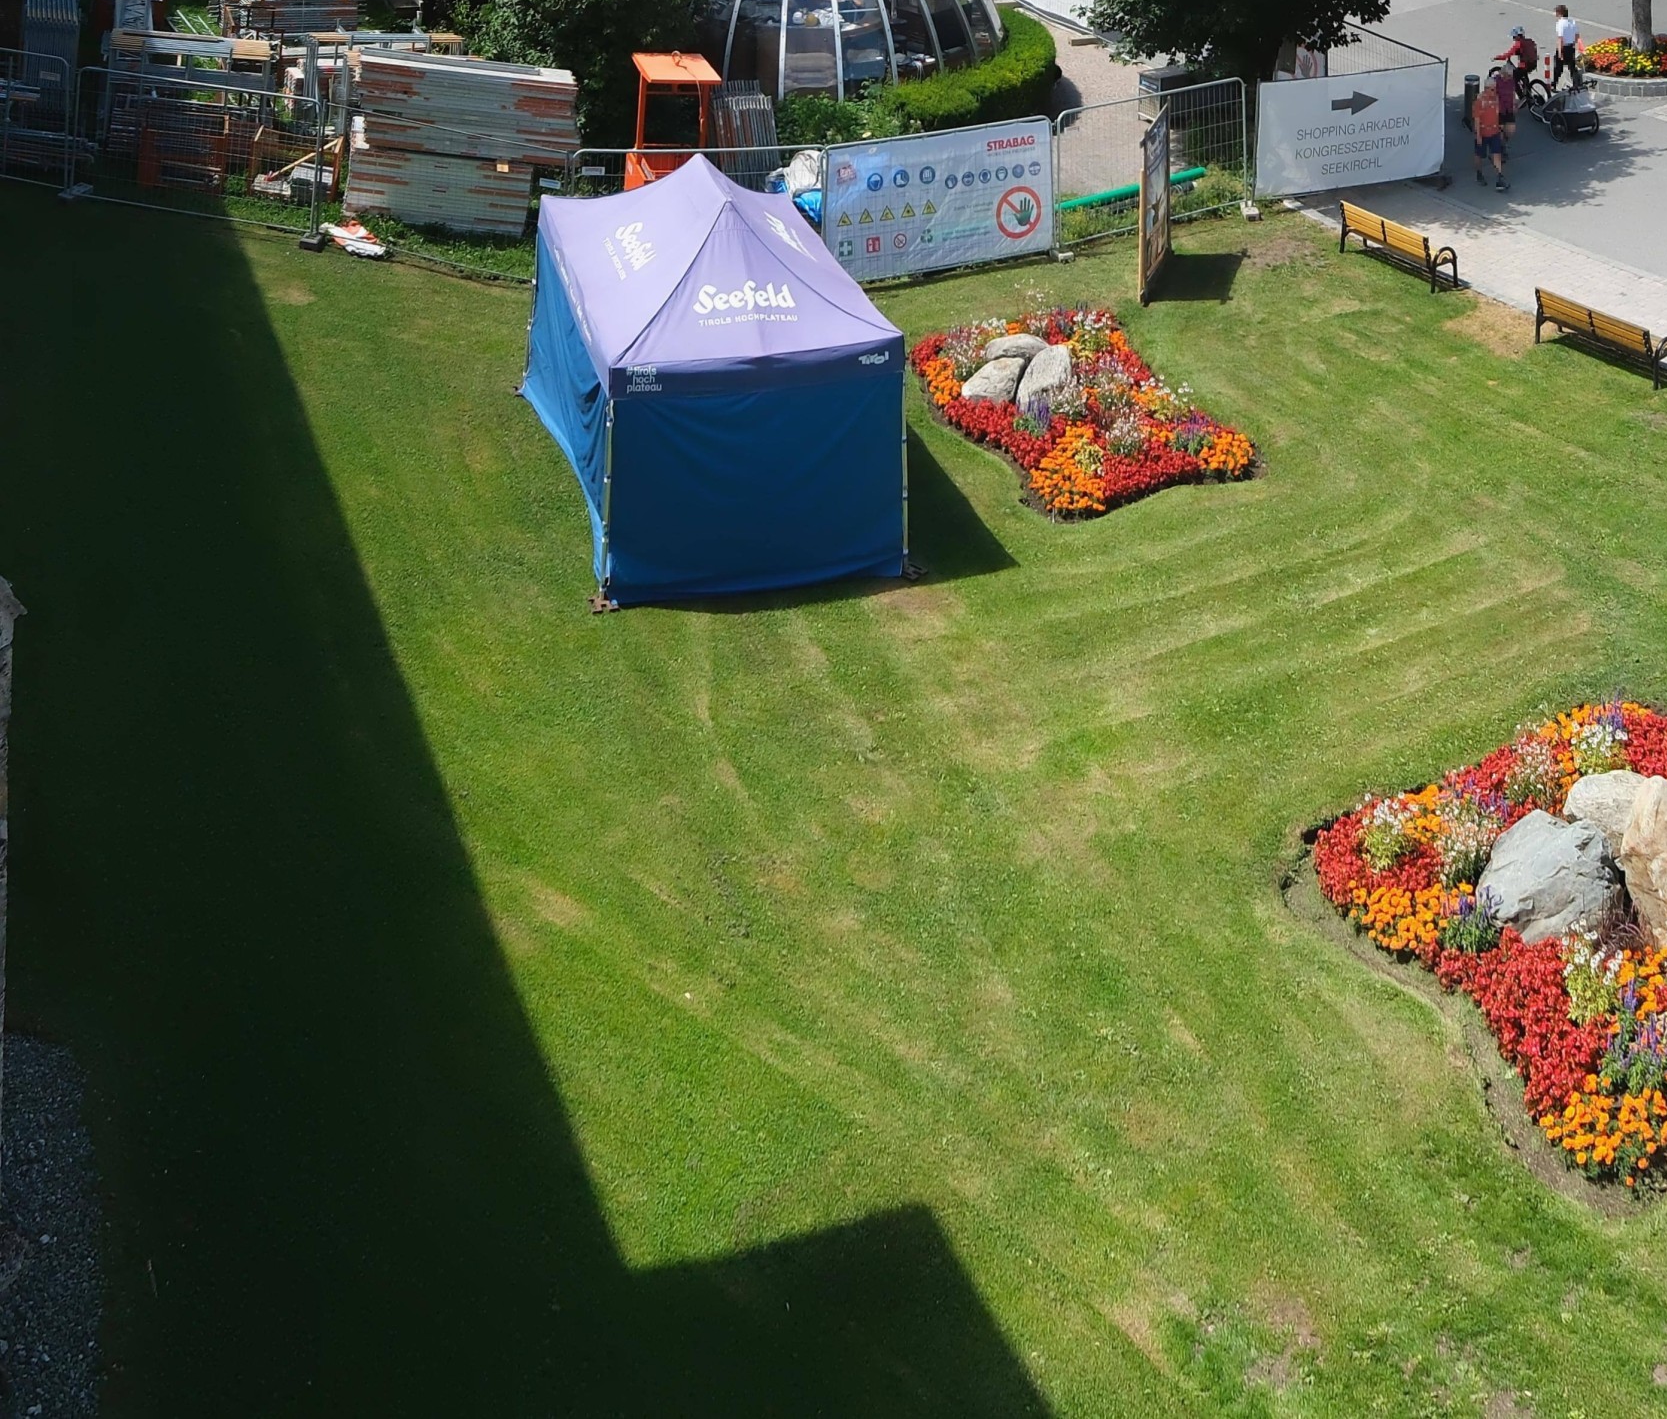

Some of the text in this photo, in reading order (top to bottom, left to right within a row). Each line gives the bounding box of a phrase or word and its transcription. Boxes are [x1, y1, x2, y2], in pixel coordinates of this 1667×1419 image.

[1296, 116, 1411, 141] SHOPPING ARKADEN
[986, 135, 1036, 152] STRABAG
[1294, 134, 1411, 160] KONGRESSZENTRUM
[1321, 157, 1383, 175] SEEKIRCHL
[692, 280, 796, 315] Seefeld
[698, 312, 799, 327] TIROLS HOCHPLATEAU
[626, 366, 657, 377] #tirols
[632, 374, 655, 385] hoch
[627, 382, 663, 394] plateau
